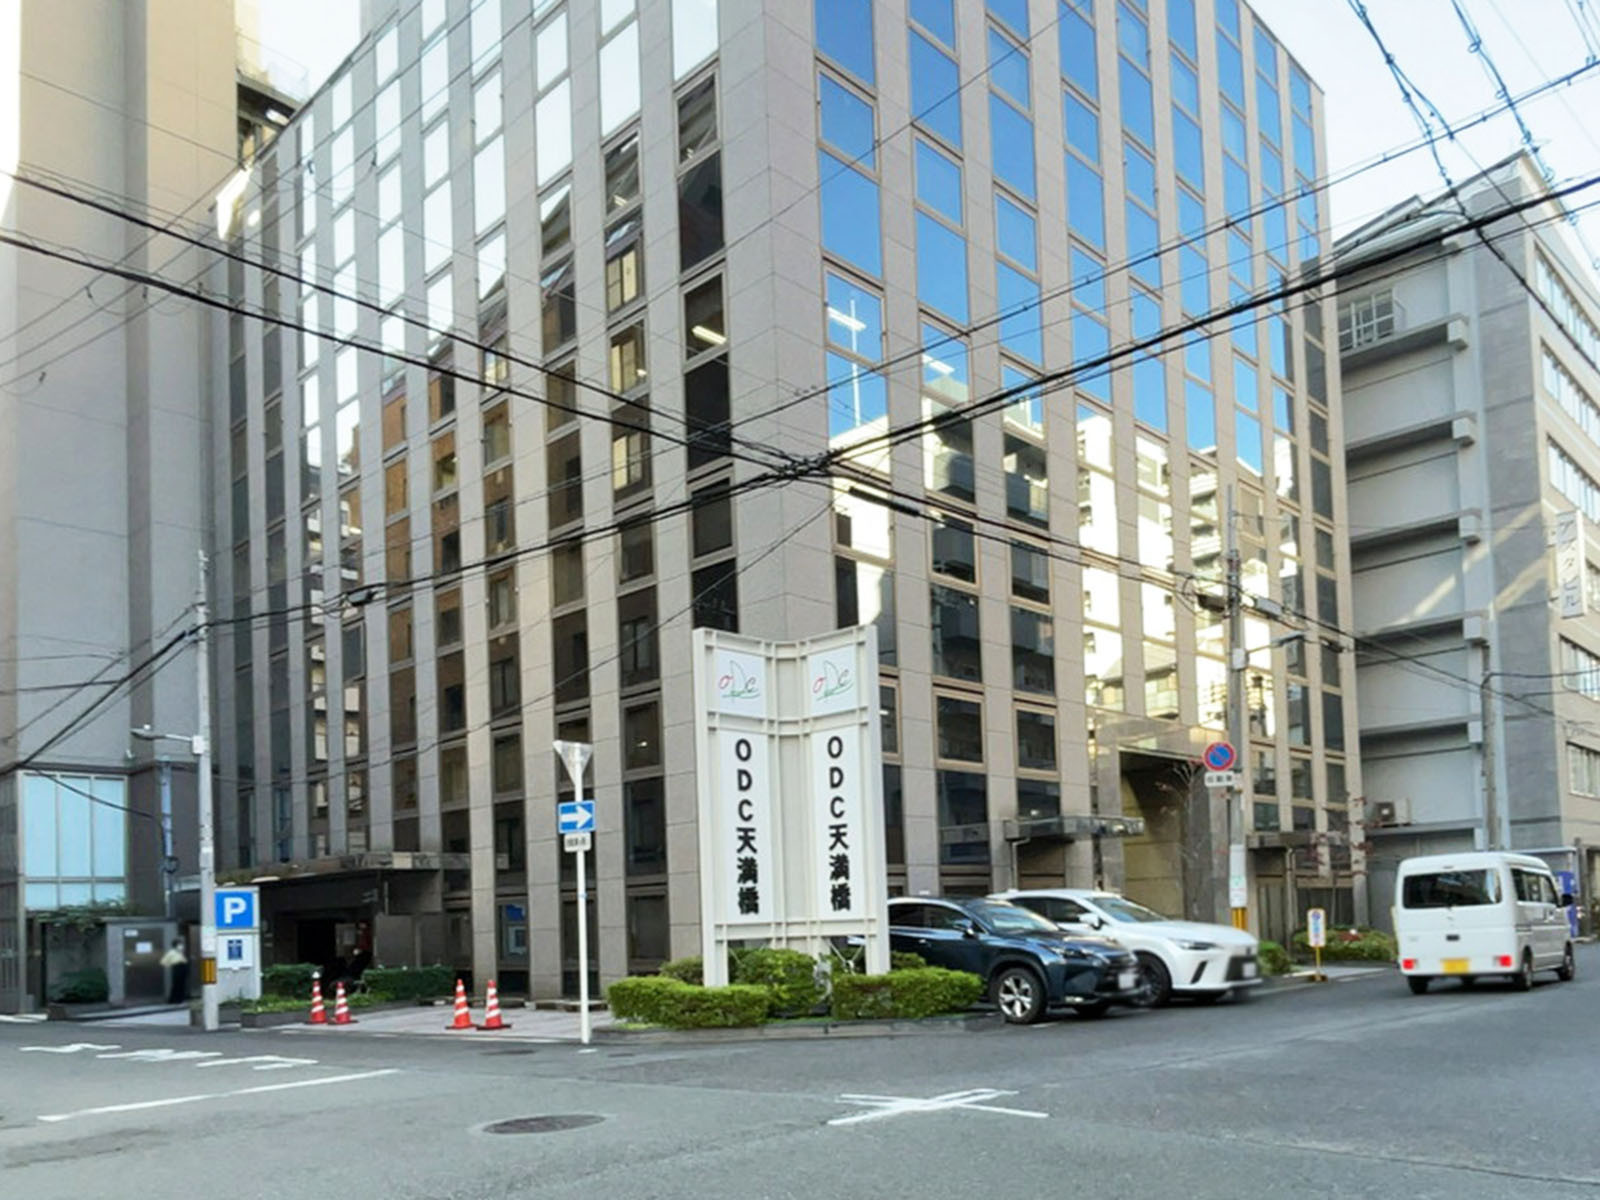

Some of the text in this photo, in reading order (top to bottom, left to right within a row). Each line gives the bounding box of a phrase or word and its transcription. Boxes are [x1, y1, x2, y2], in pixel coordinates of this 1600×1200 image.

[223, 896, 247, 925] P
[735, 738, 760, 915] ODC天満橋
[827, 735, 851, 911] ODC天満橋
